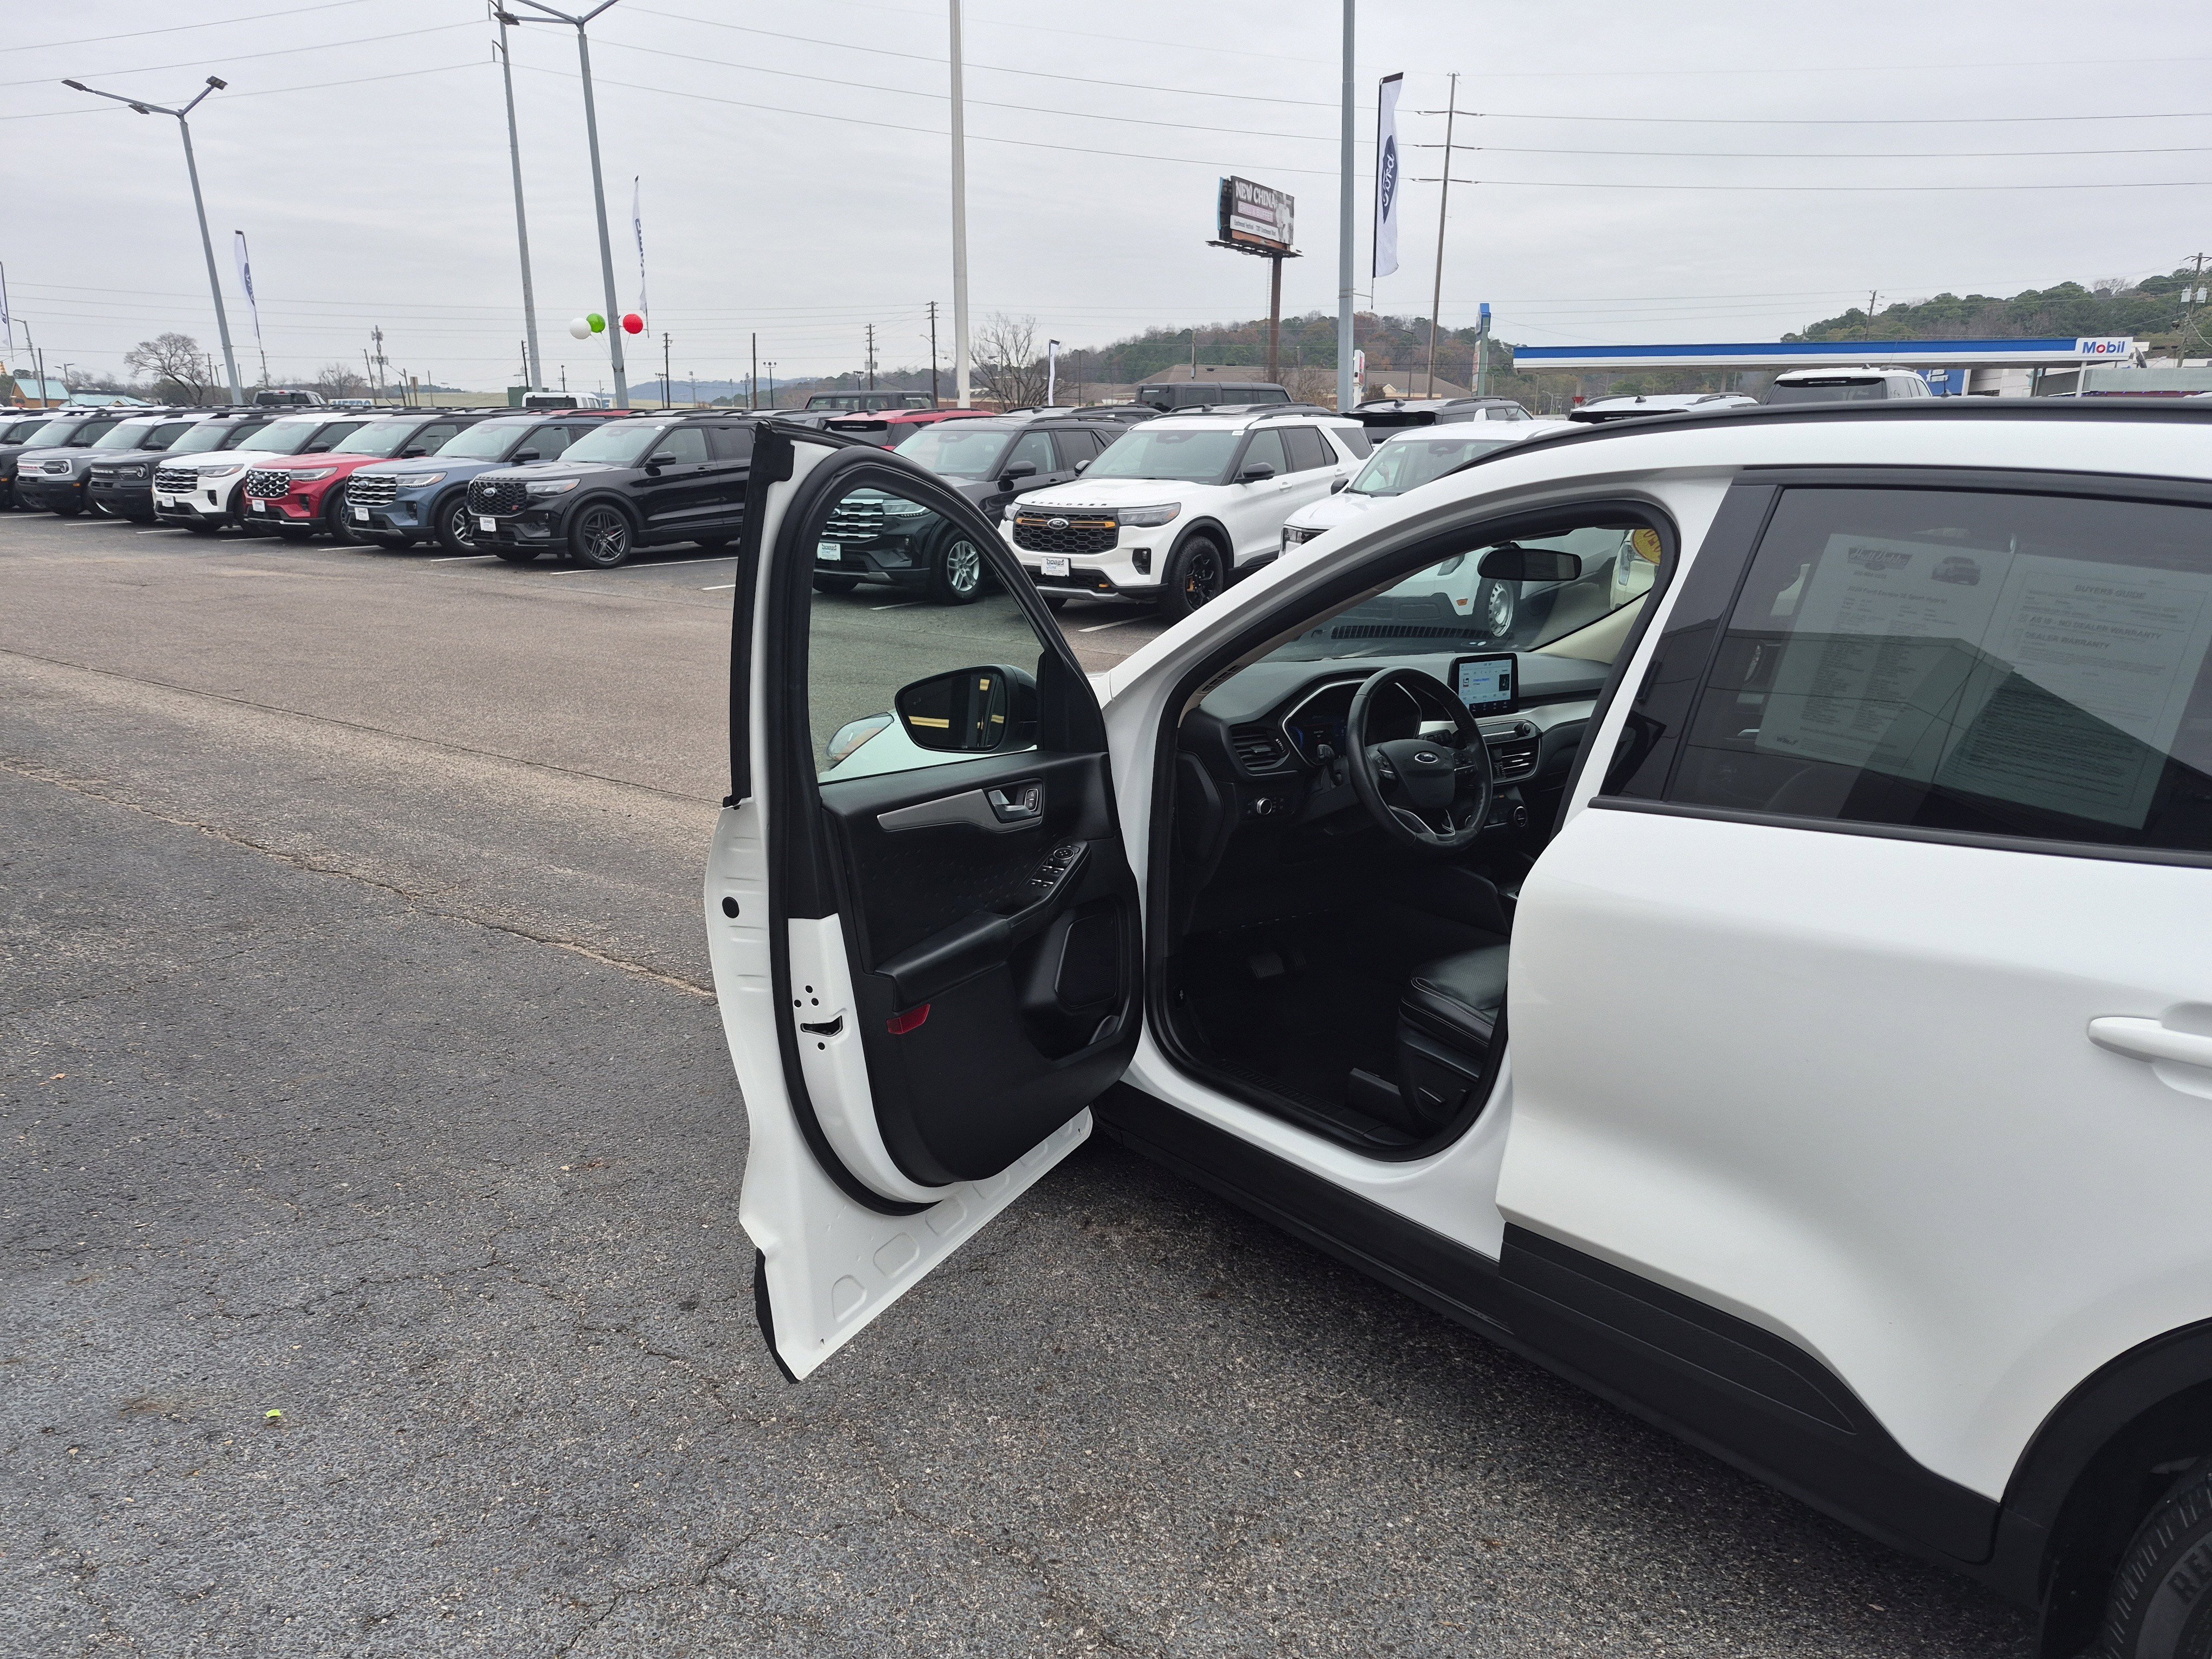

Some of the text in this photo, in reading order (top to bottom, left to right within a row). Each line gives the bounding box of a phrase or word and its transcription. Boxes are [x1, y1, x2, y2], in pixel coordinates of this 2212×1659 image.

[1382, 153, 1395, 207] Ford
[1235, 181, 1276, 209] NEW CHINA
[2082, 340, 2125, 353] Mobil
[2075, 584, 2146, 599] BUYERS GUIDE
[2073, 622, 2109, 632] DEALER
[2110, 627, 2162, 639] WARRANTY
[2025, 631, 2111, 649] DEALER WARRANTY
